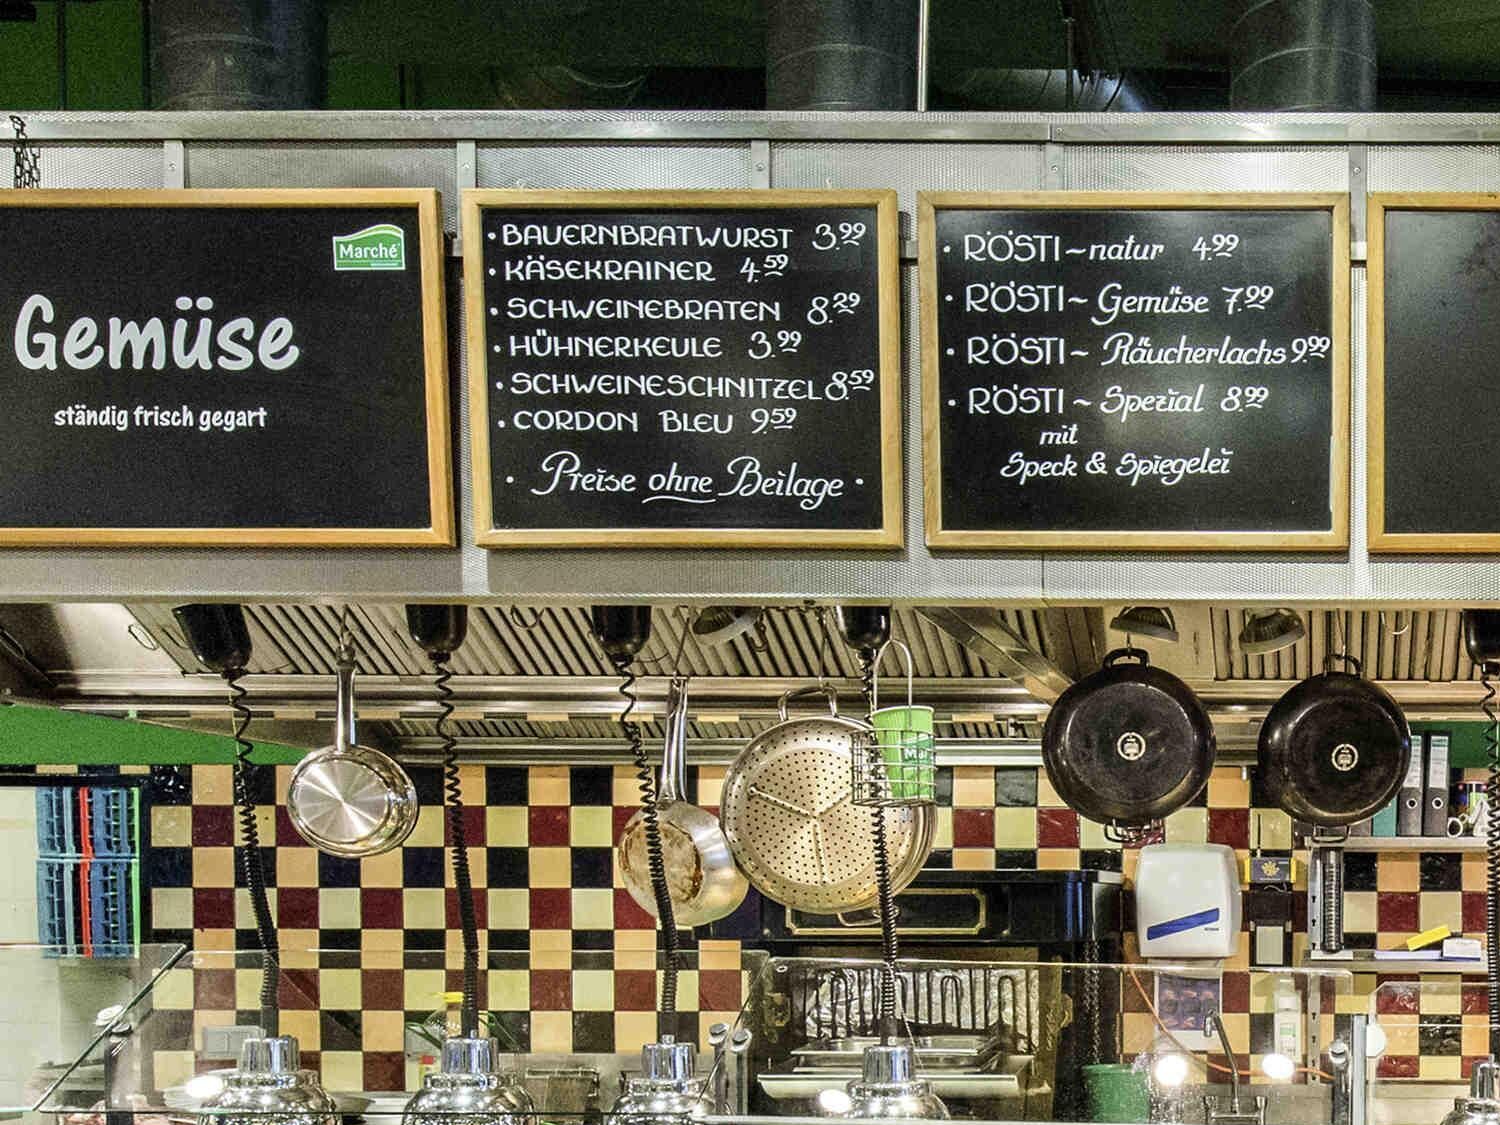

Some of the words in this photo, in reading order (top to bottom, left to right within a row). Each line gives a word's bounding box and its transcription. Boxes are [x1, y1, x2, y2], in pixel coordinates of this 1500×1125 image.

[502, 223, 793, 250] BAUERNBRATWURST
[1088, 235, 1165, 261] natur
[340, 243, 398, 259] Marché
[504, 254, 716, 282] KÄSEKRAINER
[506, 297, 781, 321] SCHWEINEBRATEN
[1090, 283, 1210, 326] Gemüse
[14, 293, 300, 372] Gemüse
[509, 328, 723, 358] HÜHNERKEULE
[1100, 331, 1287, 366] Räucherlachs
[510, 372, 823, 401] SCHWEINESCHNITZEL
[1099, 383, 1205, 423] Spezial
[54, 405, 129, 432] ständig
[133, 405, 194, 428] frisch
[199, 406, 268, 432] gegart
[513, 409, 639, 433] CORDON
[658, 409, 734, 434] BLEU
[1039, 424, 1078, 446] mit
[531, 450, 637, 496] Preise
[648, 462, 713, 493] ohne
[718, 456, 844, 510] Beilage
[1000, 451, 1078, 485] Speck
[1085, 451, 1108, 476] &
[1115, 447, 1234, 486] Spiegelei
